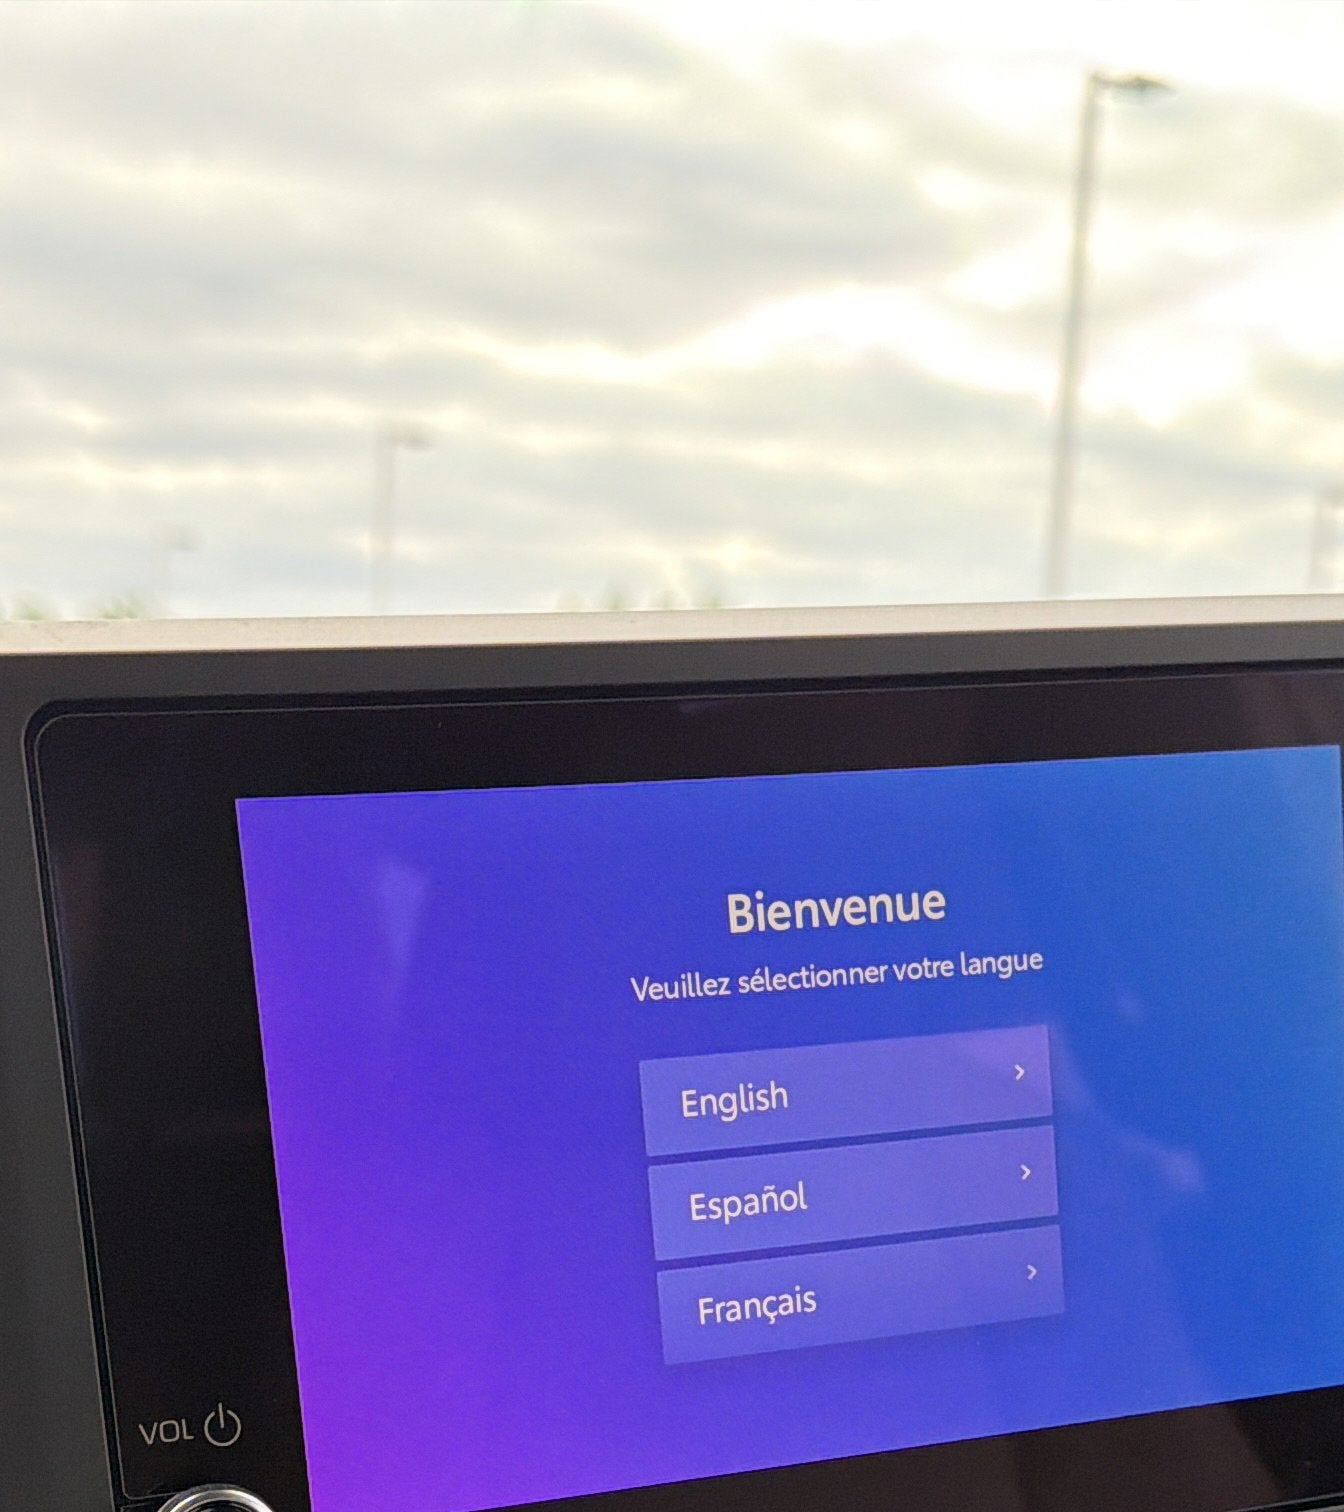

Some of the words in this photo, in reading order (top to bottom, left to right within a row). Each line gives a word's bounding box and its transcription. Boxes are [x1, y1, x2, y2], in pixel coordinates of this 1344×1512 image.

[726, 889, 947, 934] Bienvenue
[630, 971, 732, 1003] Veuillez
[738, 962, 888, 995] sélectionner
[892, 957, 955, 982] votre
[959, 950, 1044, 979] langue
[680, 1081, 789, 1123] English
[689, 1182, 808, 1226] Español
[697, 1286, 818, 1326] Français
[138, 1419, 194, 1445] VOL
